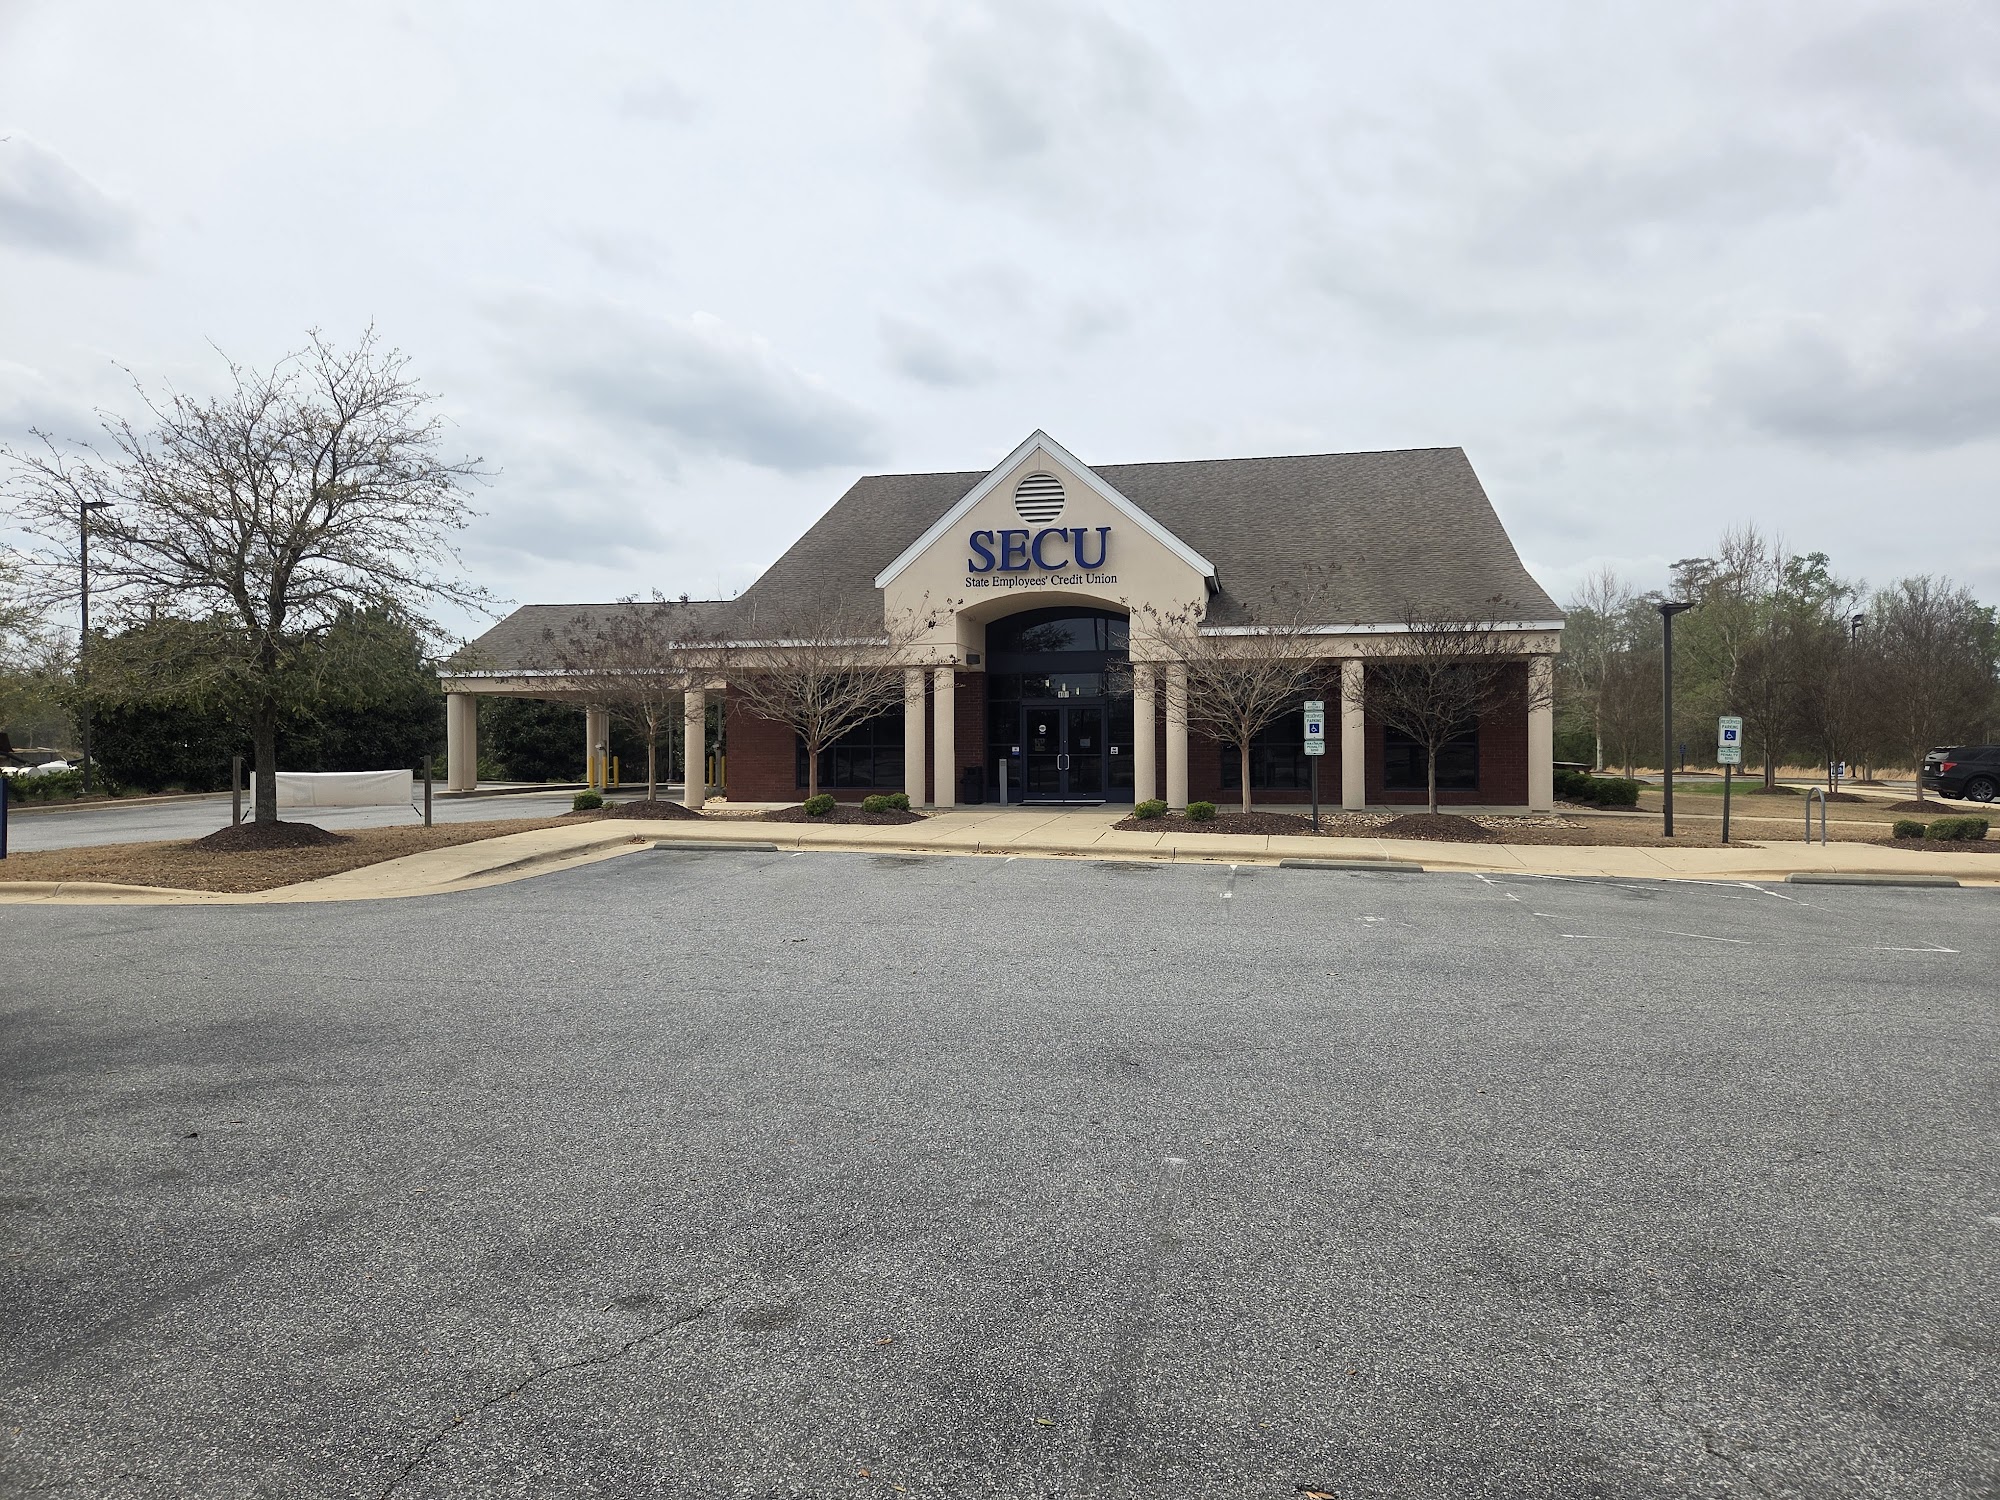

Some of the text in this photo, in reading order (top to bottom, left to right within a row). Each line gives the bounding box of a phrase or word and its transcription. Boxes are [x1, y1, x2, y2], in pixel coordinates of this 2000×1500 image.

[968, 526, 1112, 573] SECU
[965, 573, 1118, 589] State Employees' Credit Union
